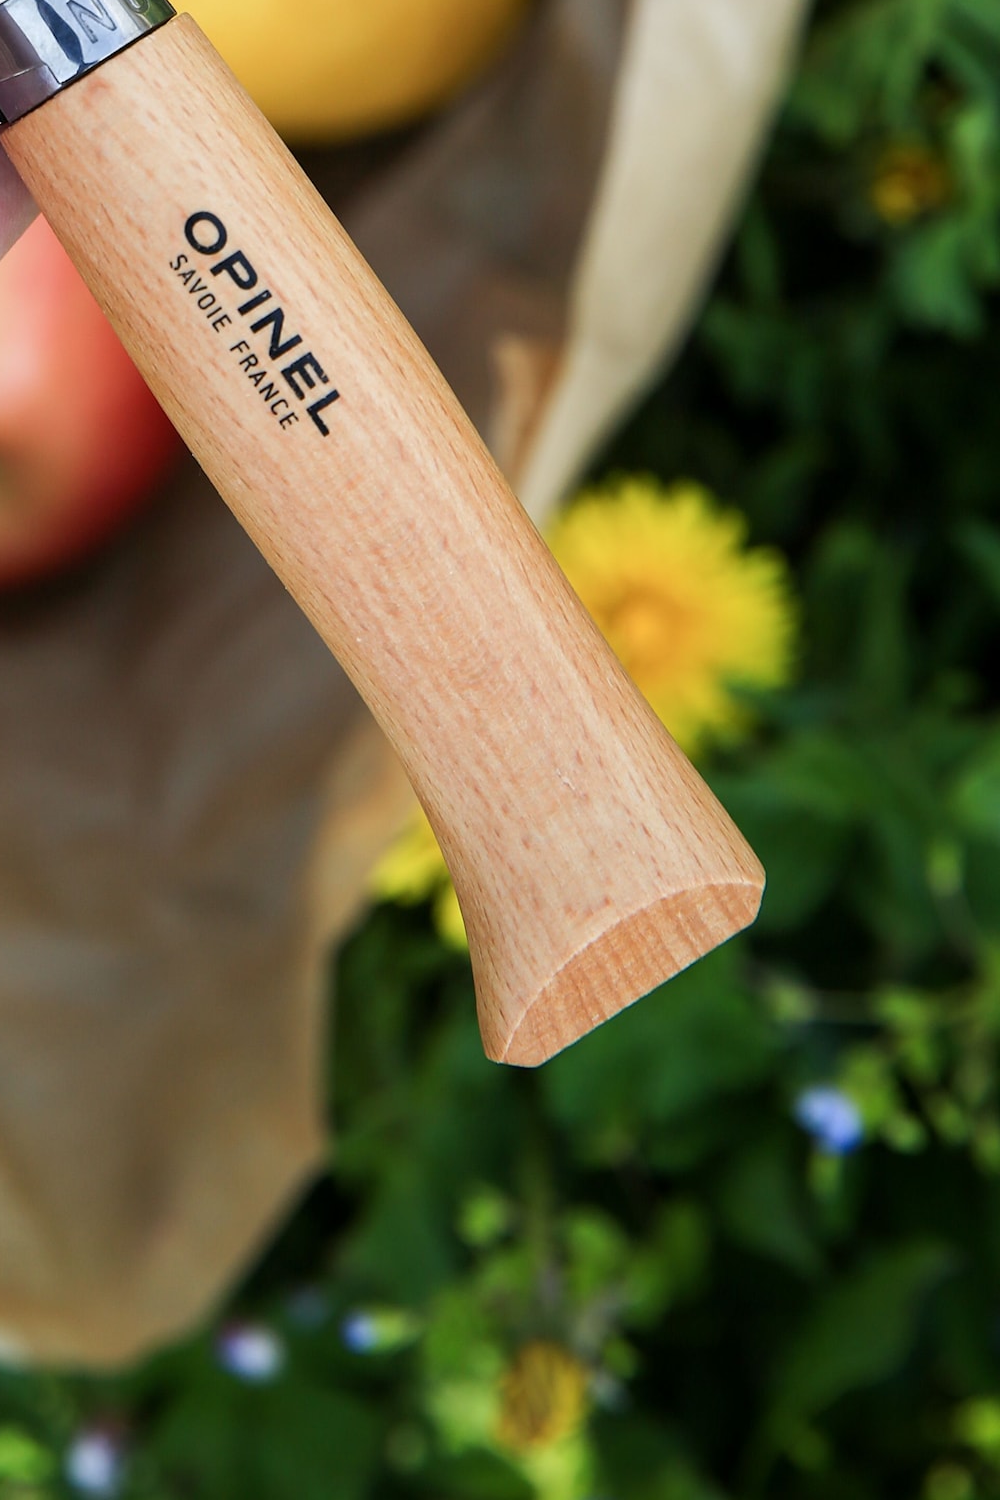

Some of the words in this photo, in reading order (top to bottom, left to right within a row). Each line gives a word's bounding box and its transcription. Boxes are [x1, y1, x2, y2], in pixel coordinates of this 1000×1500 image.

[169, 254, 233, 333] SAVOIE
[229, 340, 300, 431] FRANCE
[184, 211, 341, 438] OPINEL
